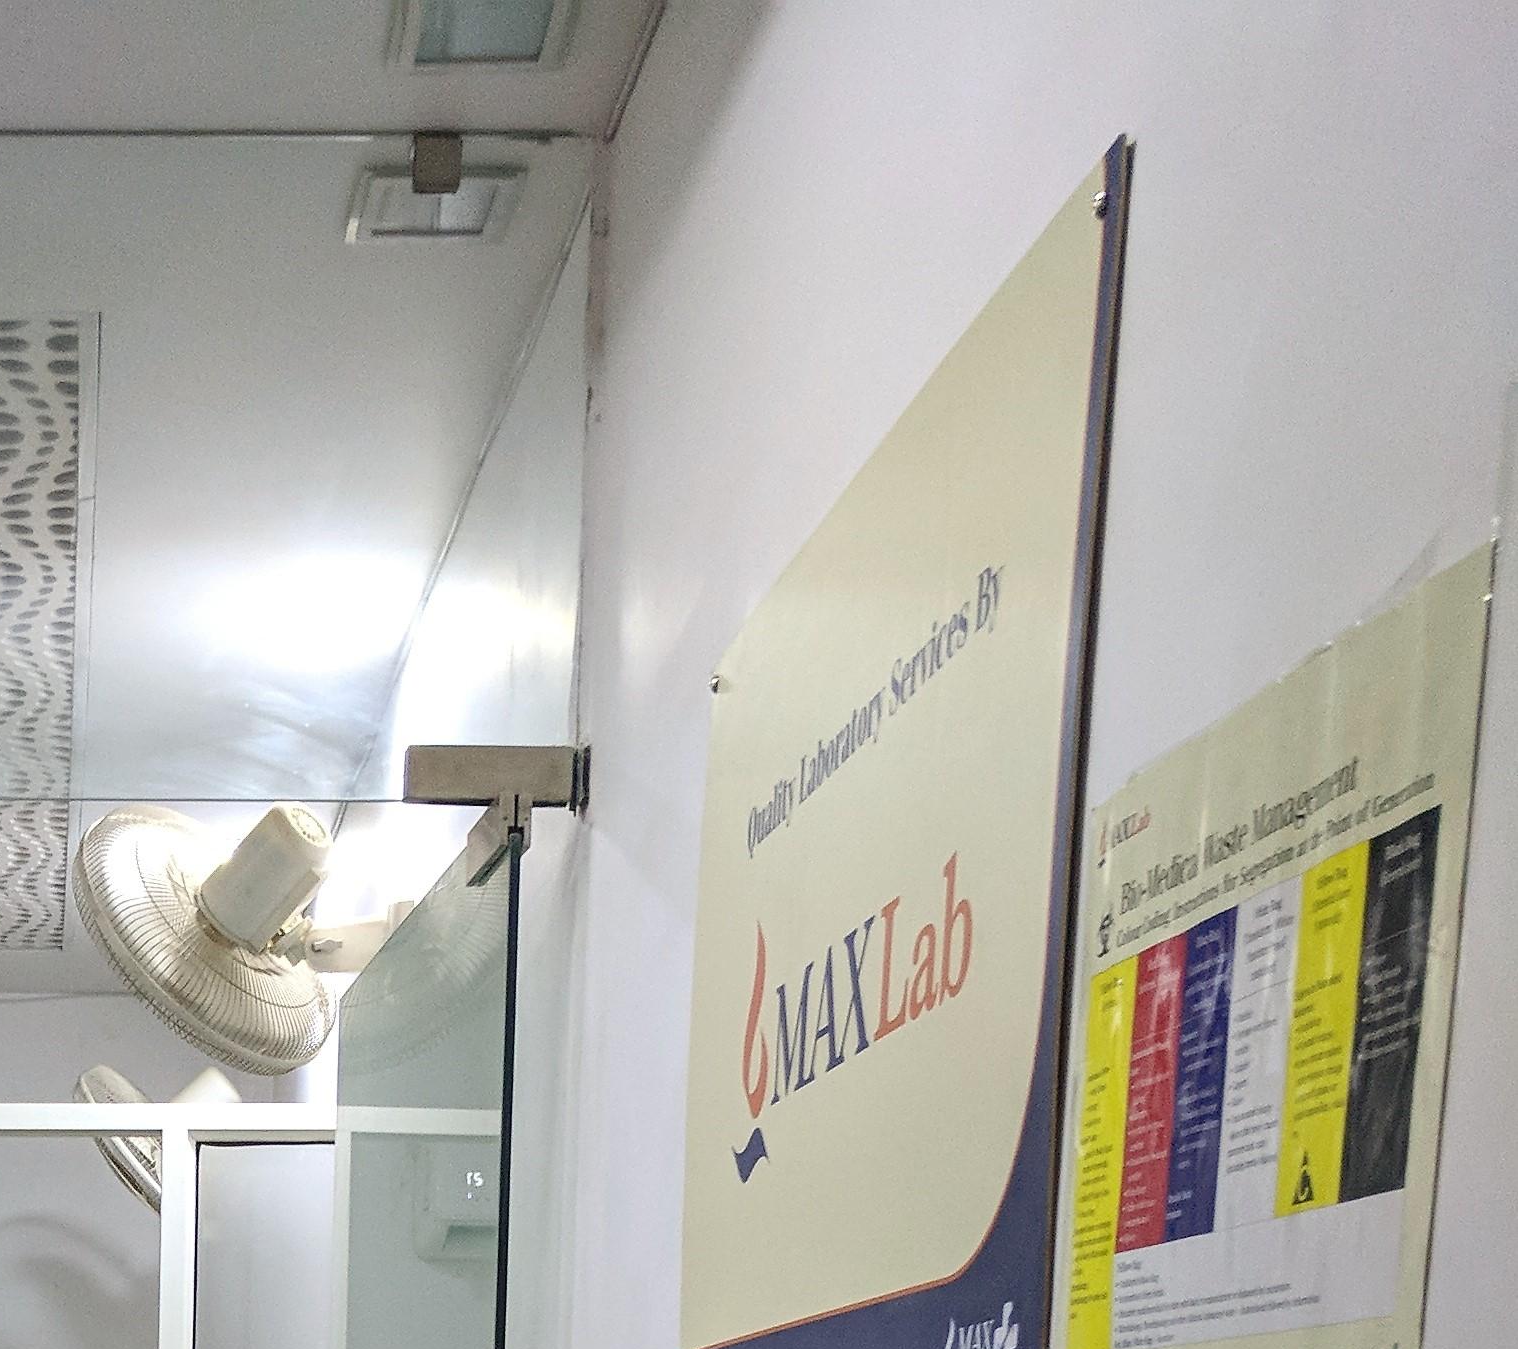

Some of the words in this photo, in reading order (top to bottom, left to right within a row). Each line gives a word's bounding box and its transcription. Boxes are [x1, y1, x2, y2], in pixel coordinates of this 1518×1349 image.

[748, 777, 796, 859] Quality
[799, 686, 886, 805] Laboratory
[889, 601, 971, 717] Services
[975, 565, 1006, 633] By
[1119, 848, 1203, 915] Bio-Medica
[1251, 756, 1358, 845] Management
[771, 850, 973, 1106] MAXLab
